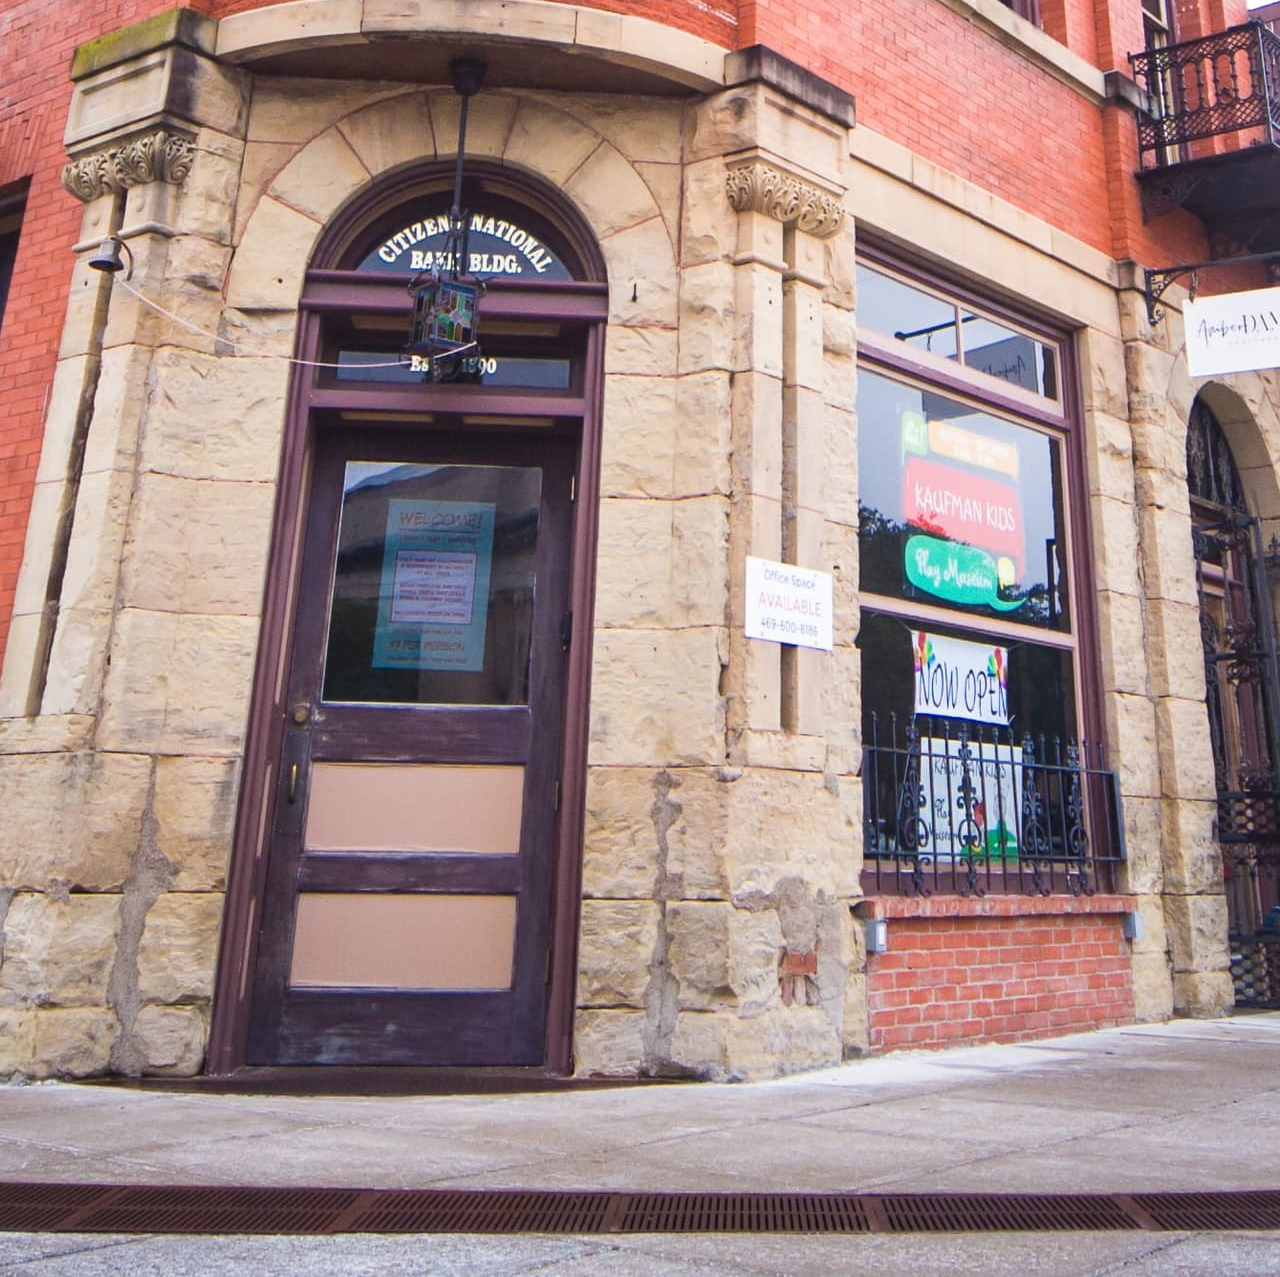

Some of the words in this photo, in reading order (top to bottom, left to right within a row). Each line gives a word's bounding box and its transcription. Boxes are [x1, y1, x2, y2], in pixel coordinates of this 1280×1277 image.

[378, 215, 461, 263] CITIZEN
[470, 214, 553, 273] NATIONAL
[470, 253, 522, 273] BLDG.
[914, 482, 984, 524] KAUFMAN
[986, 503, 1016, 532] KIDS
[764, 569, 790, 584] Office
[791, 574, 816, 590] Space
[914, 547, 941, 589] Play
[943, 556, 993, 590] Museum
[758, 591, 823, 617] AVAILABLE
[917, 663, 959, 708] NOW
[964, 670, 1008, 719] OPEN
